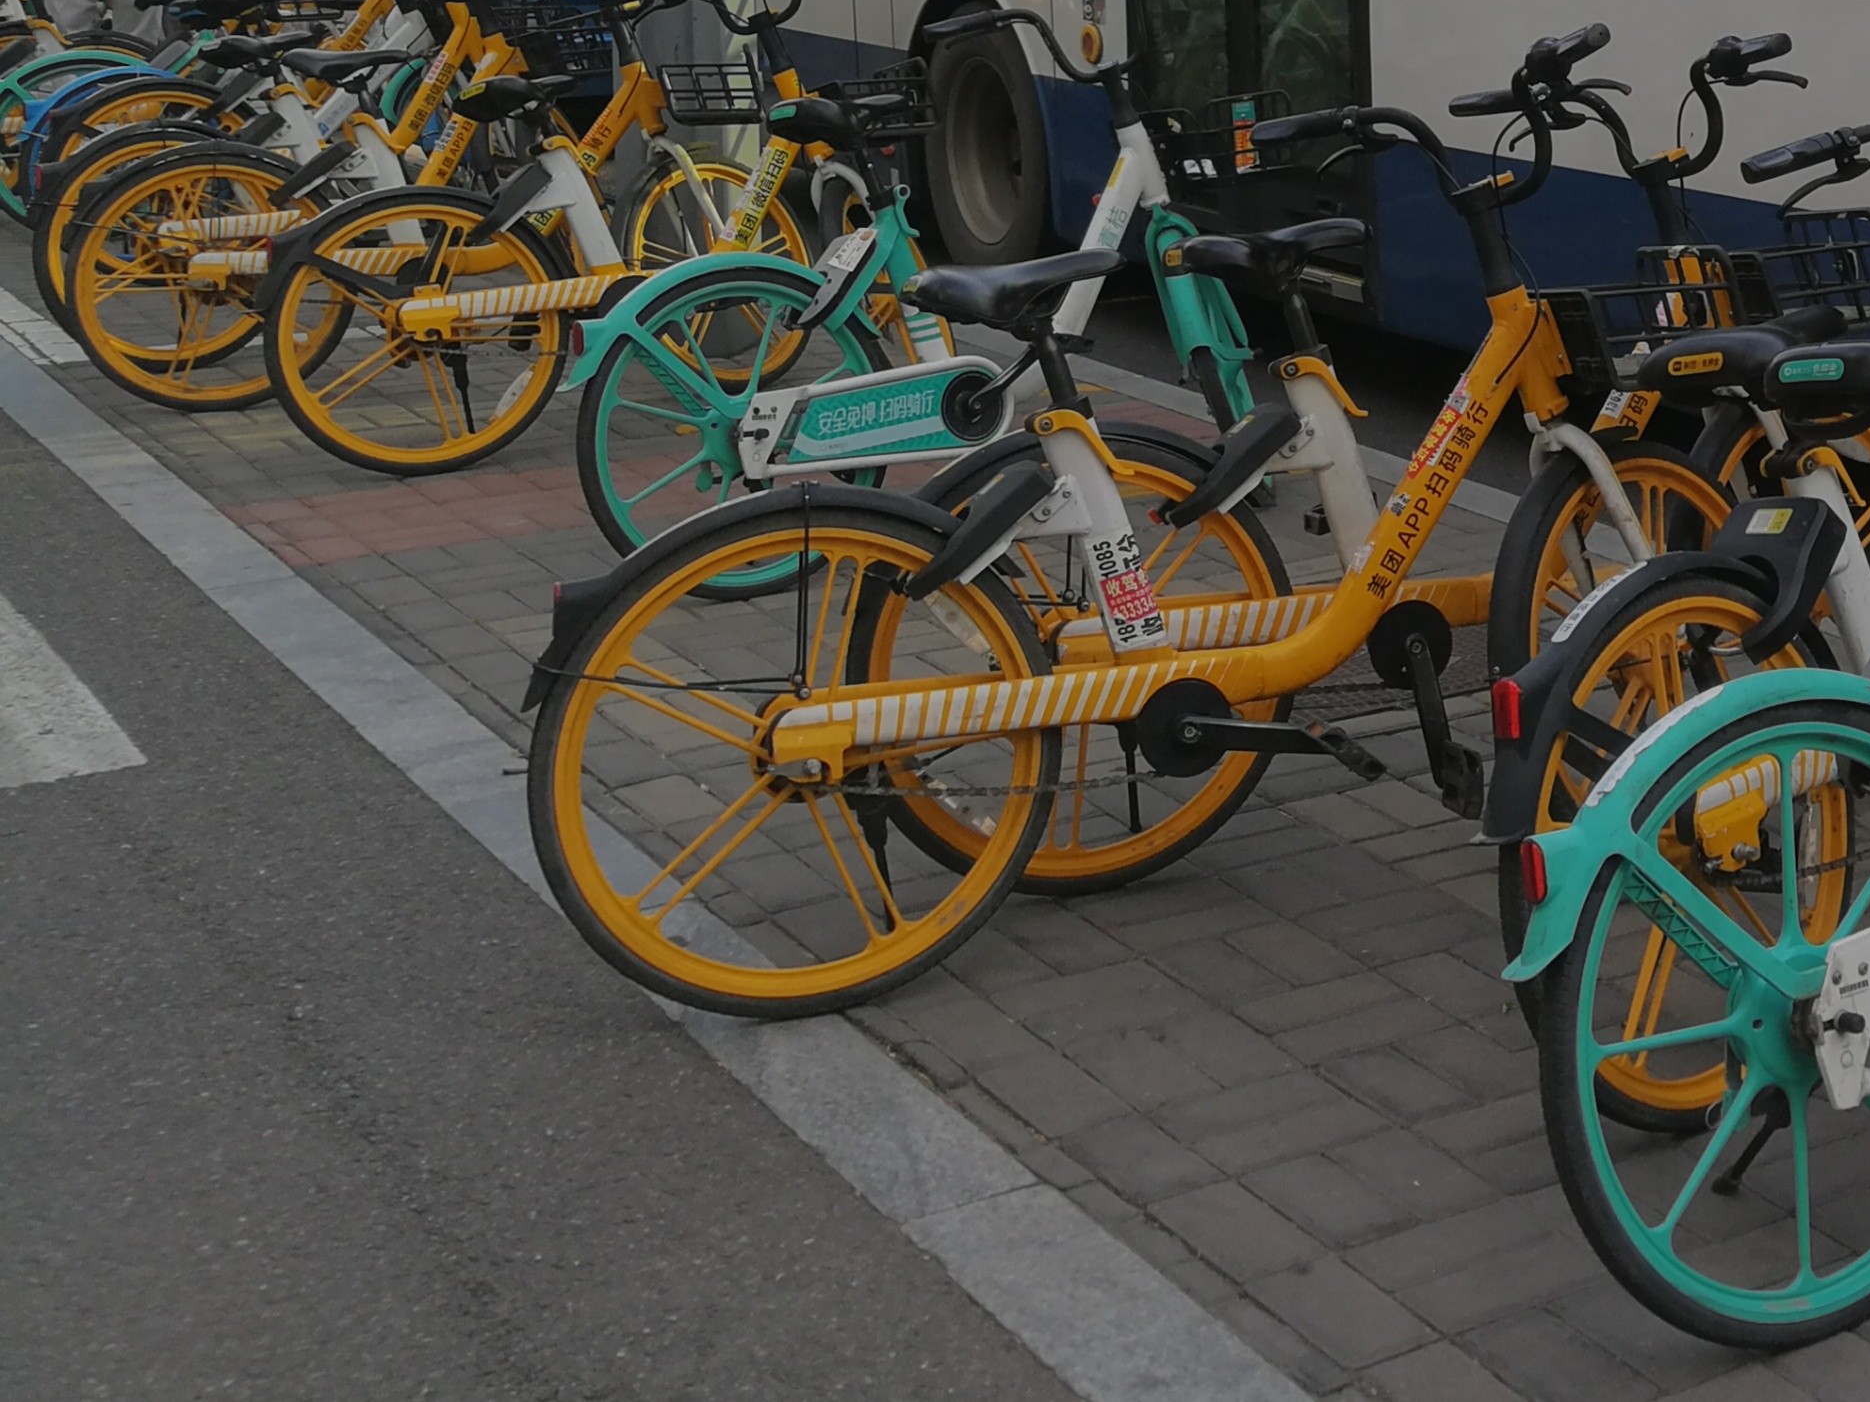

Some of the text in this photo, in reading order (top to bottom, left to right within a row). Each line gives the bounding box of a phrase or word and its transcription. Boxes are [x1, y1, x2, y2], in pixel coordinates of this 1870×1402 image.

[817, 389, 936, 435] 安全免押 扫码骑行
[1366, 399, 1490, 599] 美团APP扫码骑行
